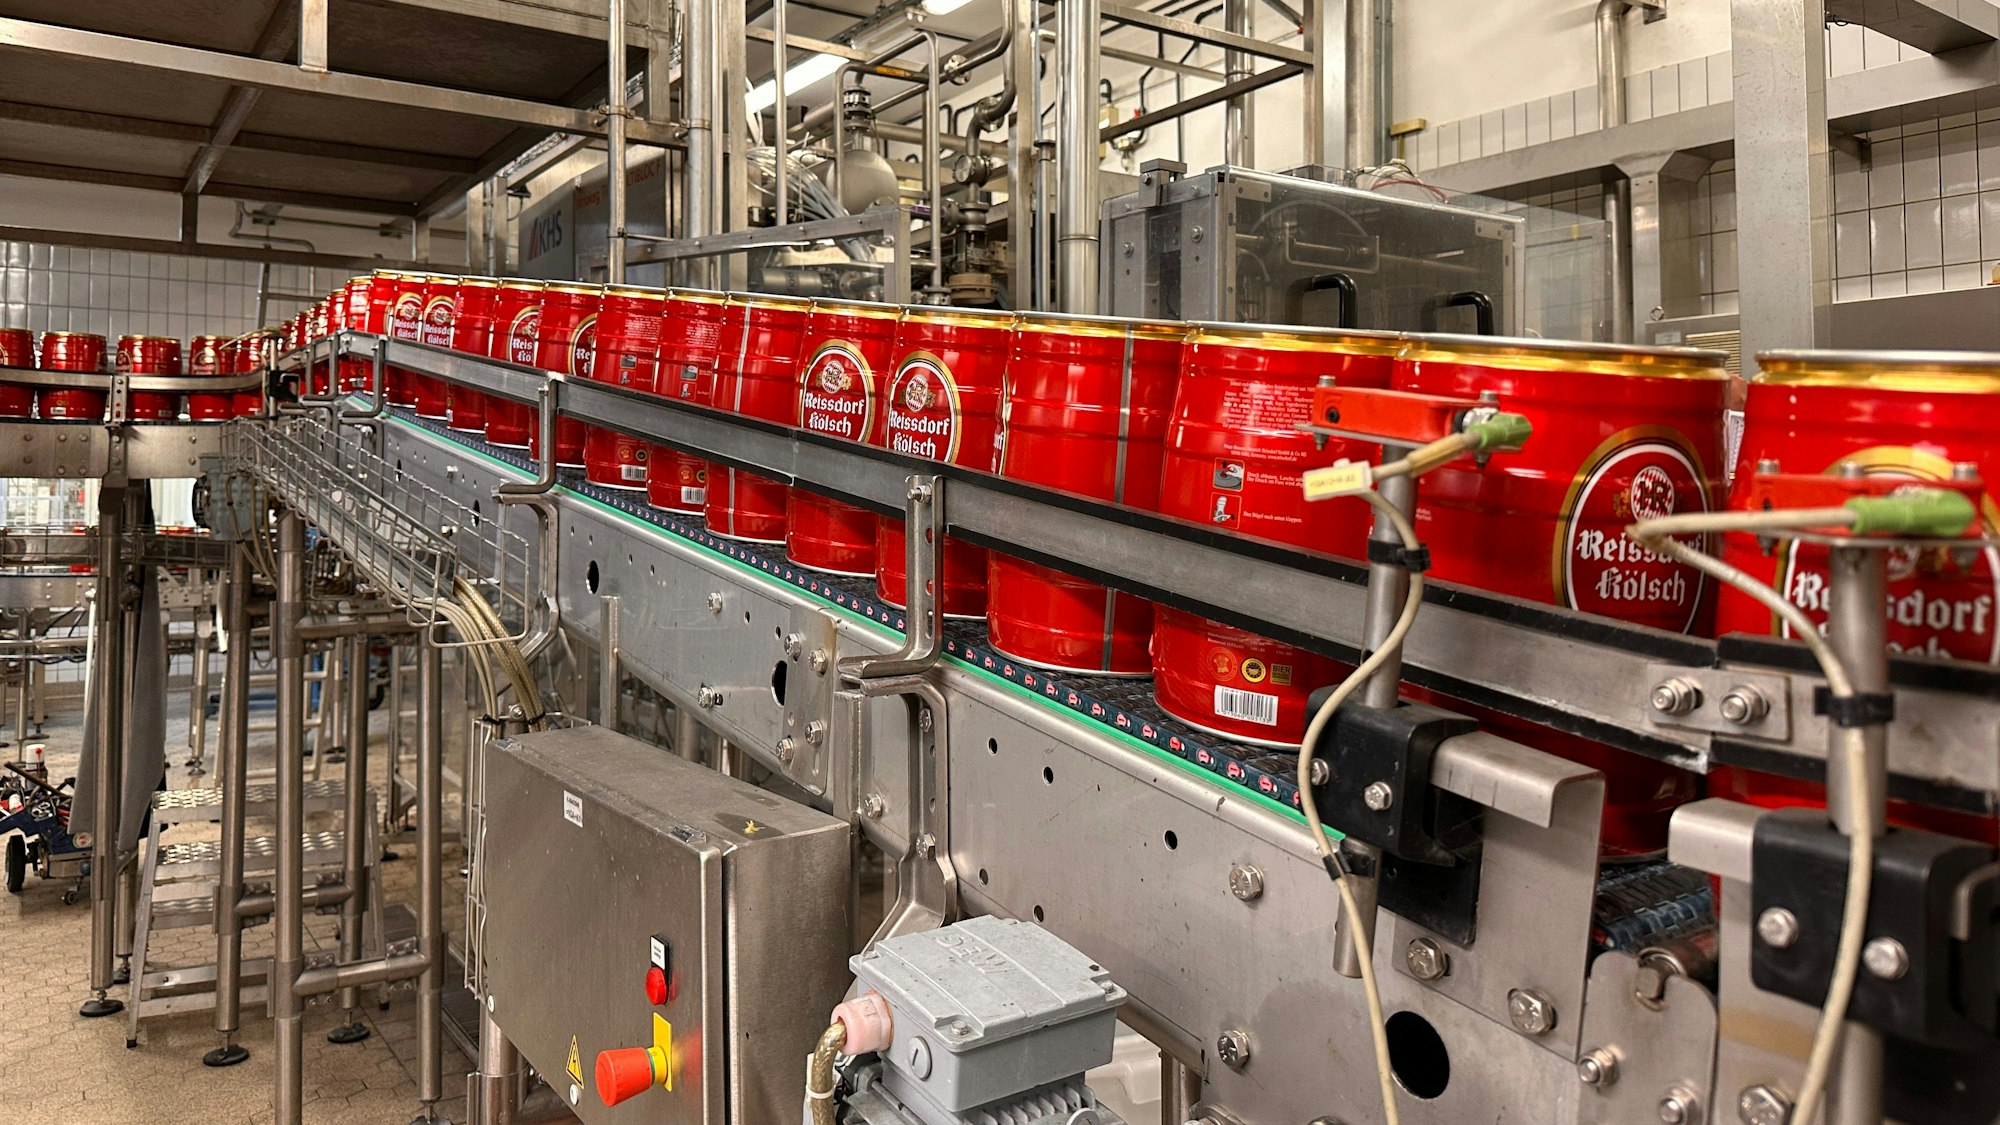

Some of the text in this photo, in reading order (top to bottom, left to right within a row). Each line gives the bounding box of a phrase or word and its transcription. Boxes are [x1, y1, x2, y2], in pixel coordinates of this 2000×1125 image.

[538, 209, 563, 254] KHS
[804, 392, 865, 415] Reissdorf
[808, 411, 852, 437] Kölsch
[889, 410, 950, 436] Reissdorf
[893, 431, 936, 460] Kölsch
[1595, 566, 1686, 607] Kölsch
[1272, 665, 1291, 674] BIER
[935, 935, 1013, 975] SEW
